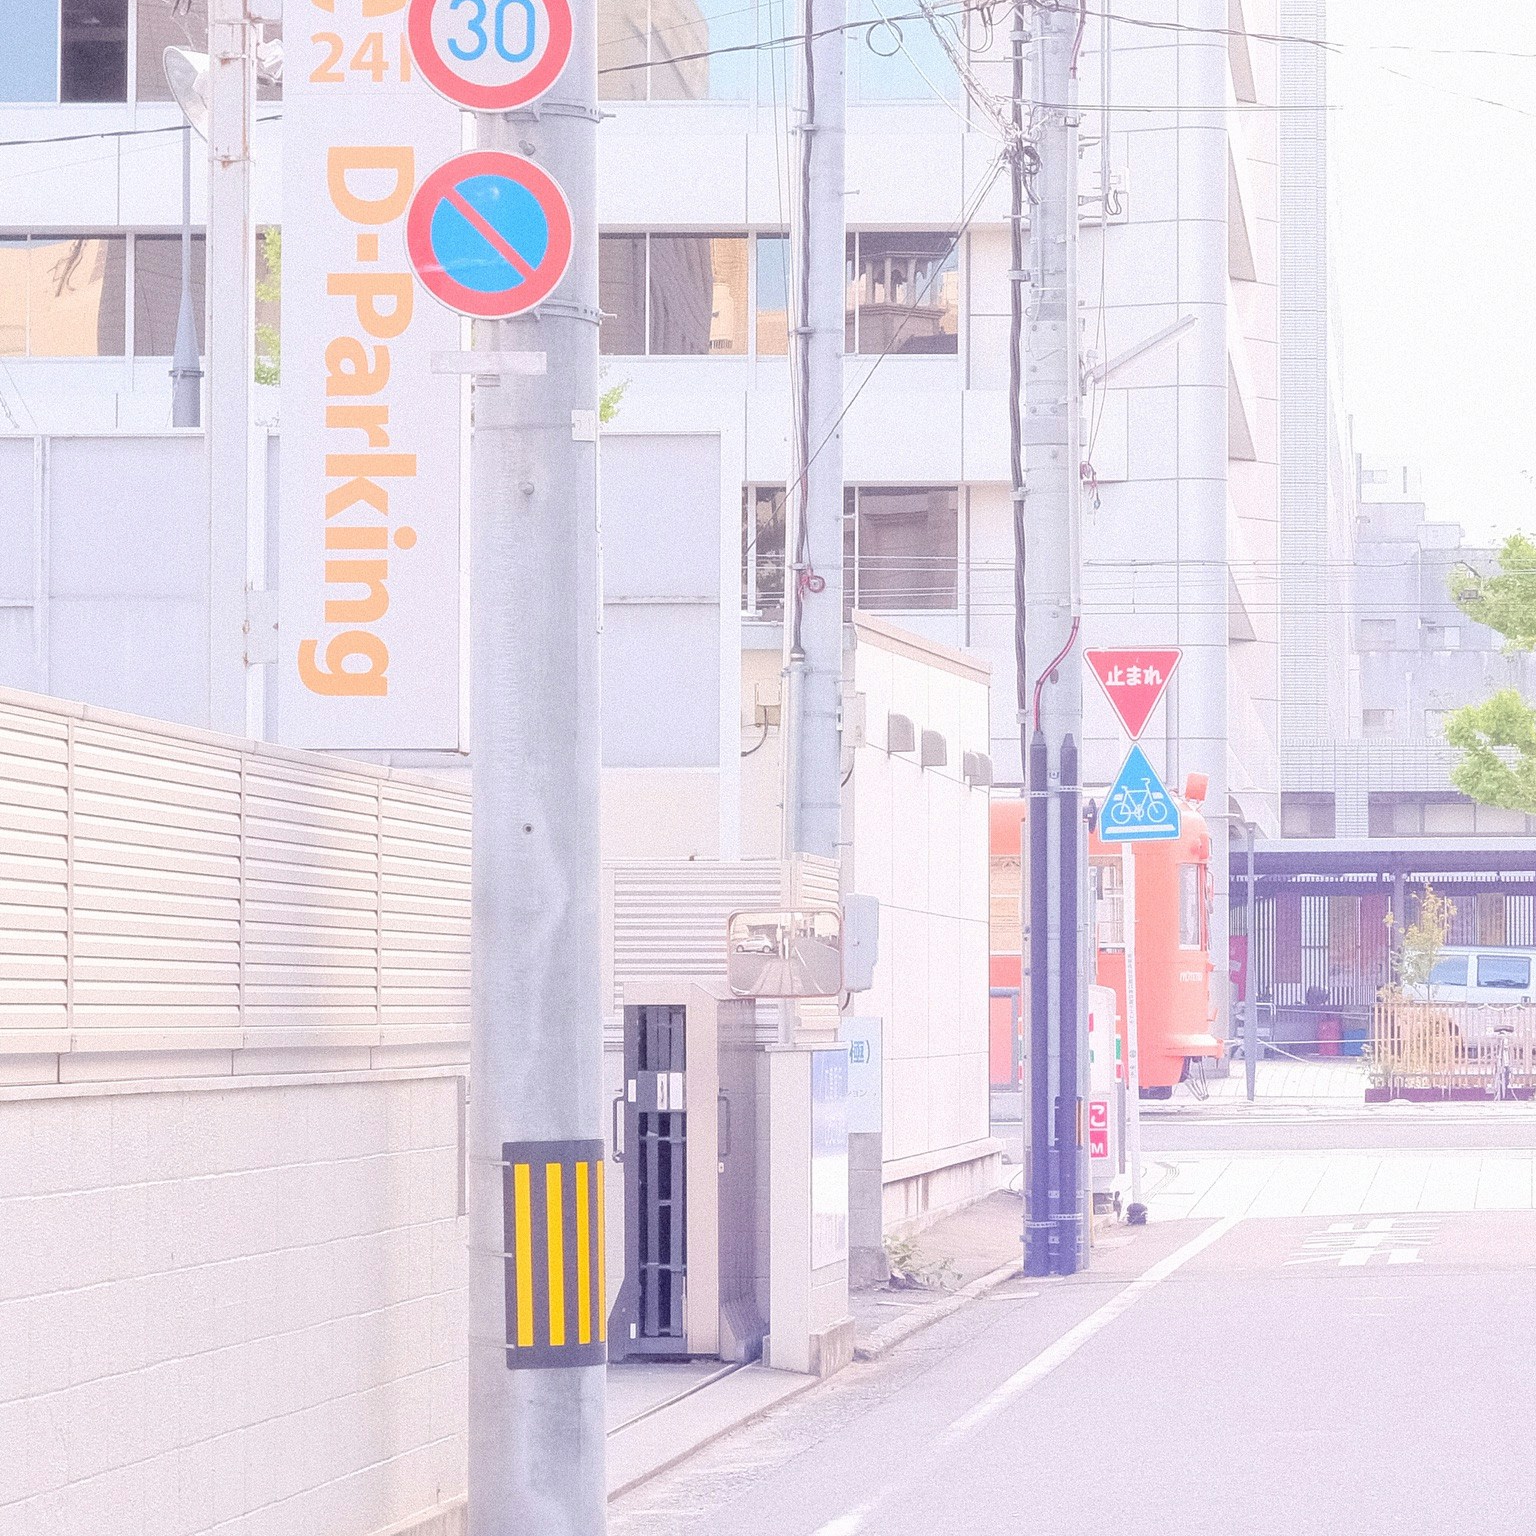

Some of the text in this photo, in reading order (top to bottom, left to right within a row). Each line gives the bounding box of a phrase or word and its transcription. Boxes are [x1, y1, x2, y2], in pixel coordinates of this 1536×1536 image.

[297, 145, 418, 697] D-Parking
[1106, 665, 1162, 686] 止まれ
